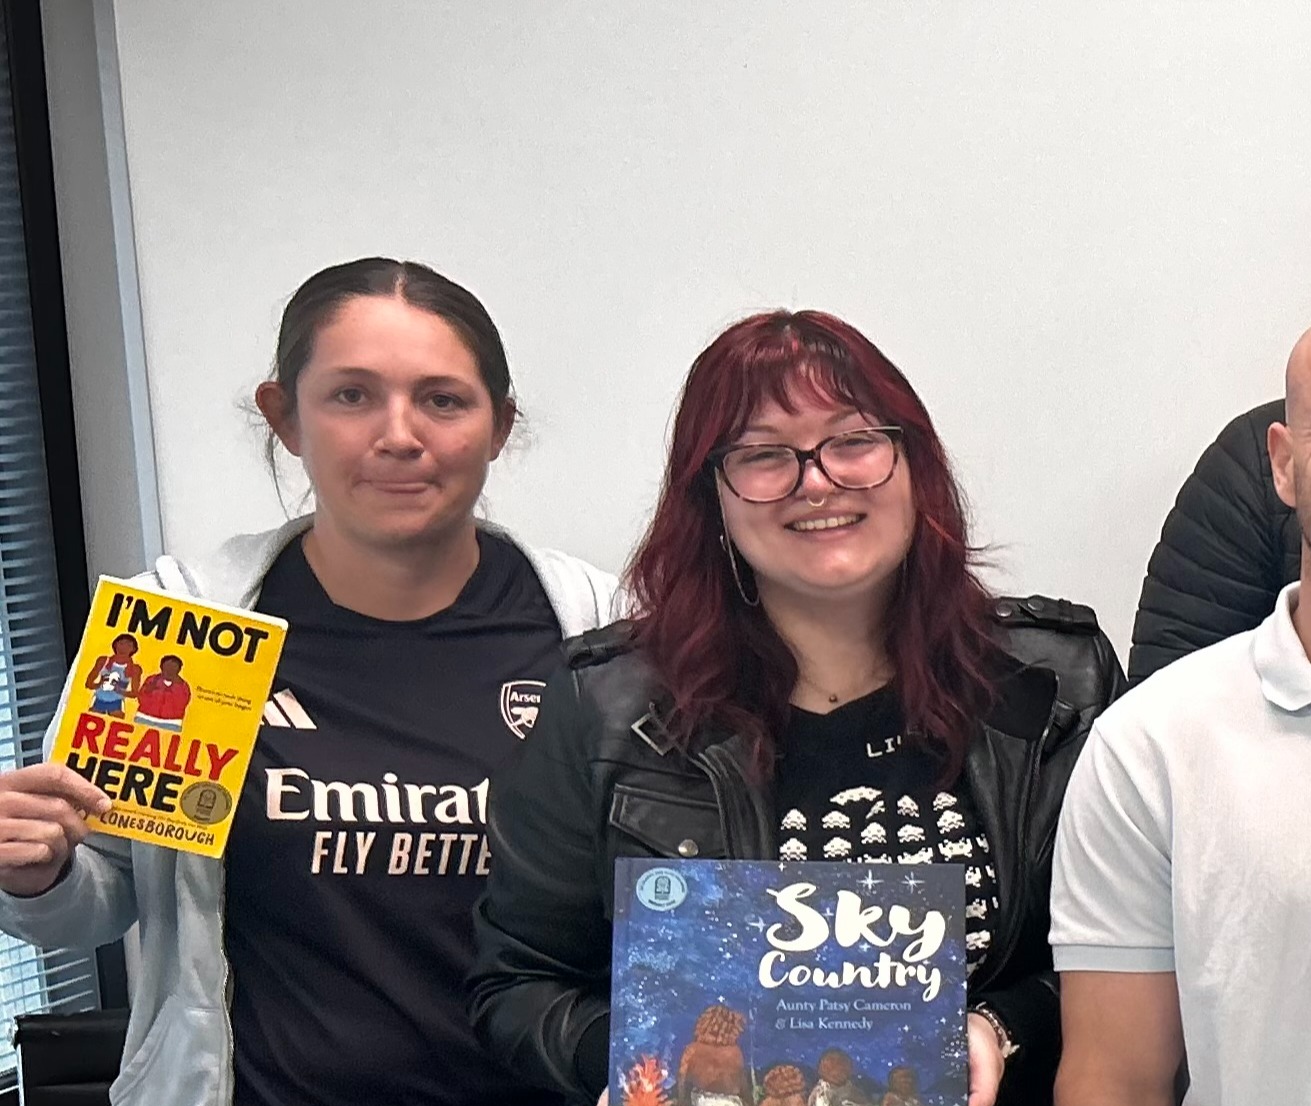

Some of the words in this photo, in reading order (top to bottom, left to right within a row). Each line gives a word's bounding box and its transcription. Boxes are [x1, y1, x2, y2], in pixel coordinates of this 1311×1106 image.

[106, 592, 172, 641] I'M
[176, 611, 269, 664] NOT
[71, 712, 239, 781] REALLY
[65, 752, 184, 813] HERE
[311, 830, 377, 875] FLY
[766, 881, 948, 963] Sky
[758, 950, 943, 1003] Country
[776, 998, 816, 1013] Aunty
[819, 998, 850, 1013] Patsy
[853, 998, 912, 1011] Cameron
[790, 1017, 815, 1030] Lisa
[818, 1016, 874, 1032] Kennedy
